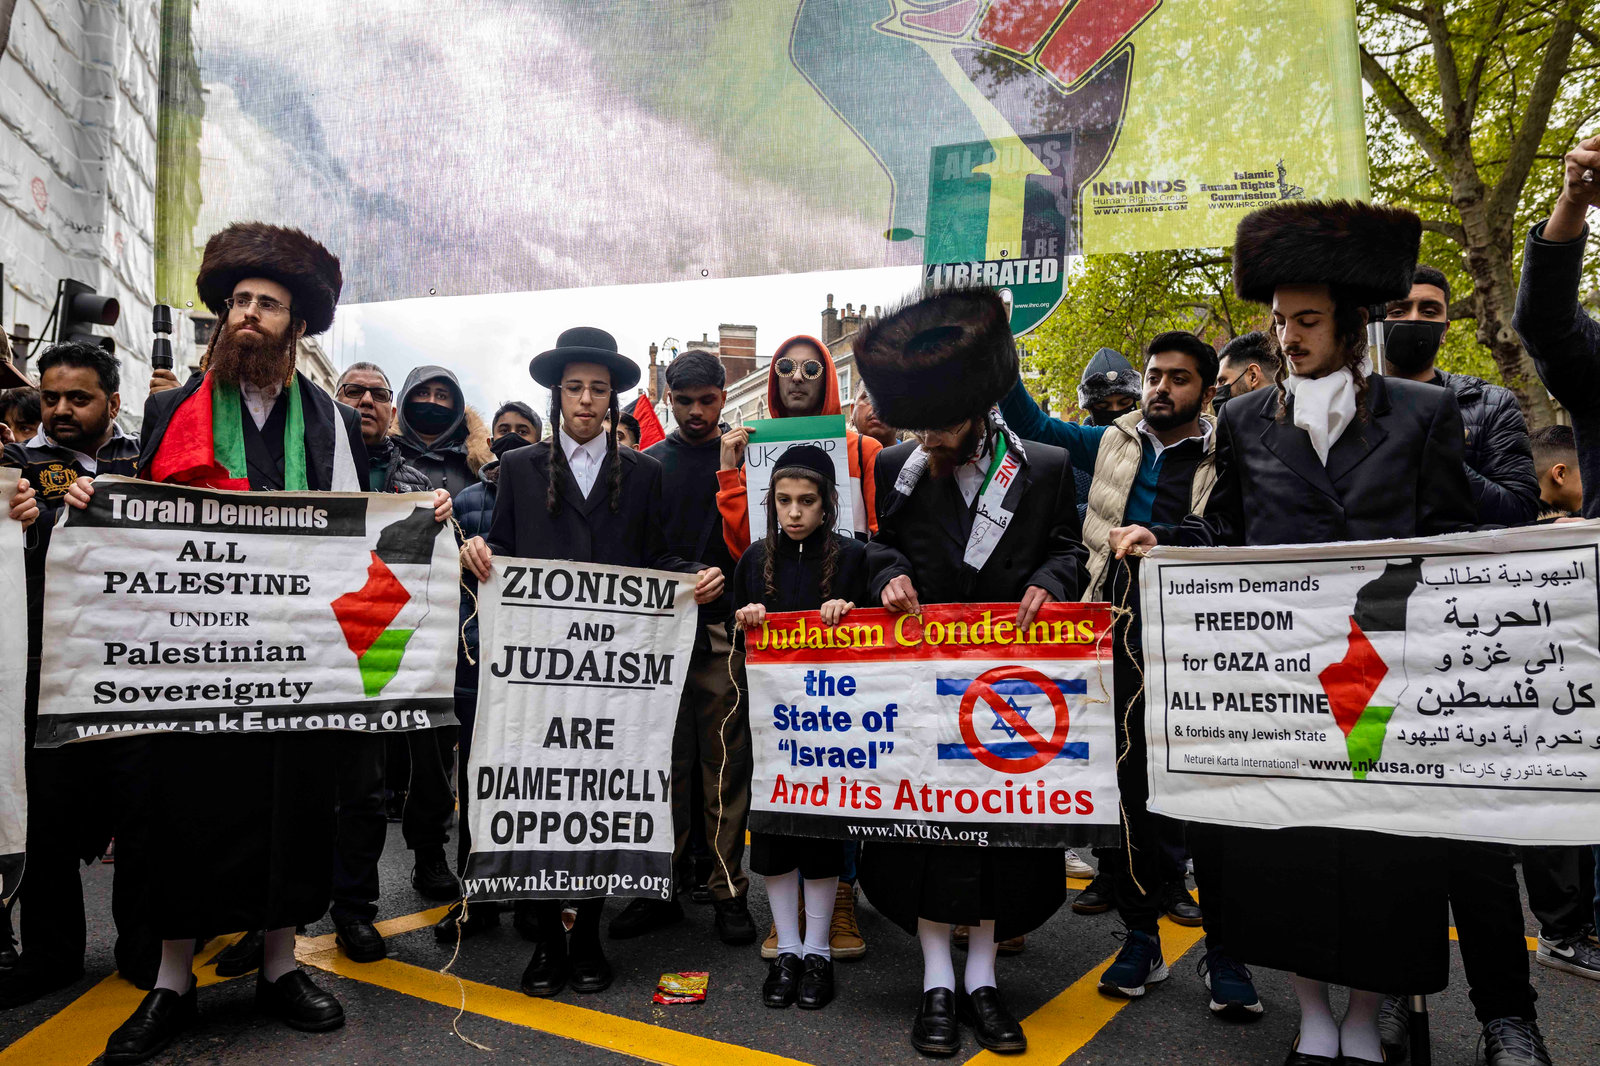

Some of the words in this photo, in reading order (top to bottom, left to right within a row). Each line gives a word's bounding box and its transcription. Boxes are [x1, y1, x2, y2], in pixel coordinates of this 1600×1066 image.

[942, 150, 974, 180] AL
[1234, 170, 1274, 180] Islamic
[1092, 179, 1187, 196] INMINDS
[1200, 182, 1237, 192] Human
[1240, 180, 1276, 192] Rights
[1210, 191, 1277, 201] Commission
[1093, 196, 1126, 206] Human
[1129, 194, 1158, 205] Rights
[1159, 193, 1188, 203] Group
[1093, 205, 1188, 216] WWW.INMINDS.COM
[1034, 237, 1059, 258] BE
[934, 258, 1058, 289] LIBERATED
[747, 446, 778, 468] UK
[109, 494, 194, 524] Torah
[202, 499, 328, 528] Demands
[176, 540, 247, 563] ALL
[103, 571, 311, 595] PALESTINE
[1168, 578, 1233, 596] Judaism
[1240, 576, 1320, 594] Demands
[1424, 566, 1491, 590] تطالب
[1499, 560, 1585, 588] اليهودية
[502, 565, 679, 609] ZIONISM
[169, 611, 250, 628] UNDER
[1194, 610, 1293, 632] FREEDOM
[1443, 597, 1552, 637] الحرية
[567, 622, 615, 642] AND
[756, 618, 884, 650] Judaism
[894, 610, 1095, 647] Condemns
[104, 639, 306, 666] Palestinian
[1182, 653, 1208, 672] for
[1213, 652, 1269, 672] GAZA
[1274, 653, 1311, 673] and
[1435, 654, 1452, 672] و
[1461, 642, 1511, 672] غزة
[1524, 642, 1565, 674] إلى
[491, 646, 675, 685] JUDAISM
[93, 677, 313, 705] Sovereignty
[804, 670, 856, 697] the
[1170, 692, 1206, 711] ALL
[1212, 692, 1330, 714] PALESTINE
[1417, 677, 1539, 717] فلسطين
[1552, 680, 1596, 715] كل
[773, 704, 852, 732] State
[862, 703, 898, 732] of
[542, 717, 615, 750] ARE
[1174, 726, 1184, 738] &
[1186, 726, 1226, 739] forbids
[1228, 730, 1249, 742] any
[1252, 728, 1291, 741] Jewish
[1295, 729, 1326, 742] State
[1397, 726, 1450, 747] لليهود
[1456, 724, 1497, 747] دولة
[1536, 729, 1583, 751] تحرم
[778, 739, 894, 770] “Israel”
[1184, 754, 1215, 766] Neturei
[1217, 755, 1239, 767] Karta
[1241, 757, 1299, 770] International
[1309, 758, 1445, 778] www.nkusa.org
[1547, 764, 1588, 780] جماعة
[477, 766, 671, 803] DIAMETRICLLY
[770, 773, 830, 807] And
[839, 776, 883, 810] its
[893, 778, 1094, 815] Atrocities
[490, 811, 654, 845] OPPOSED
[847, 823, 989, 847] www.NKUSA.org
[464, 869, 670, 899] www.nkEurope.org
